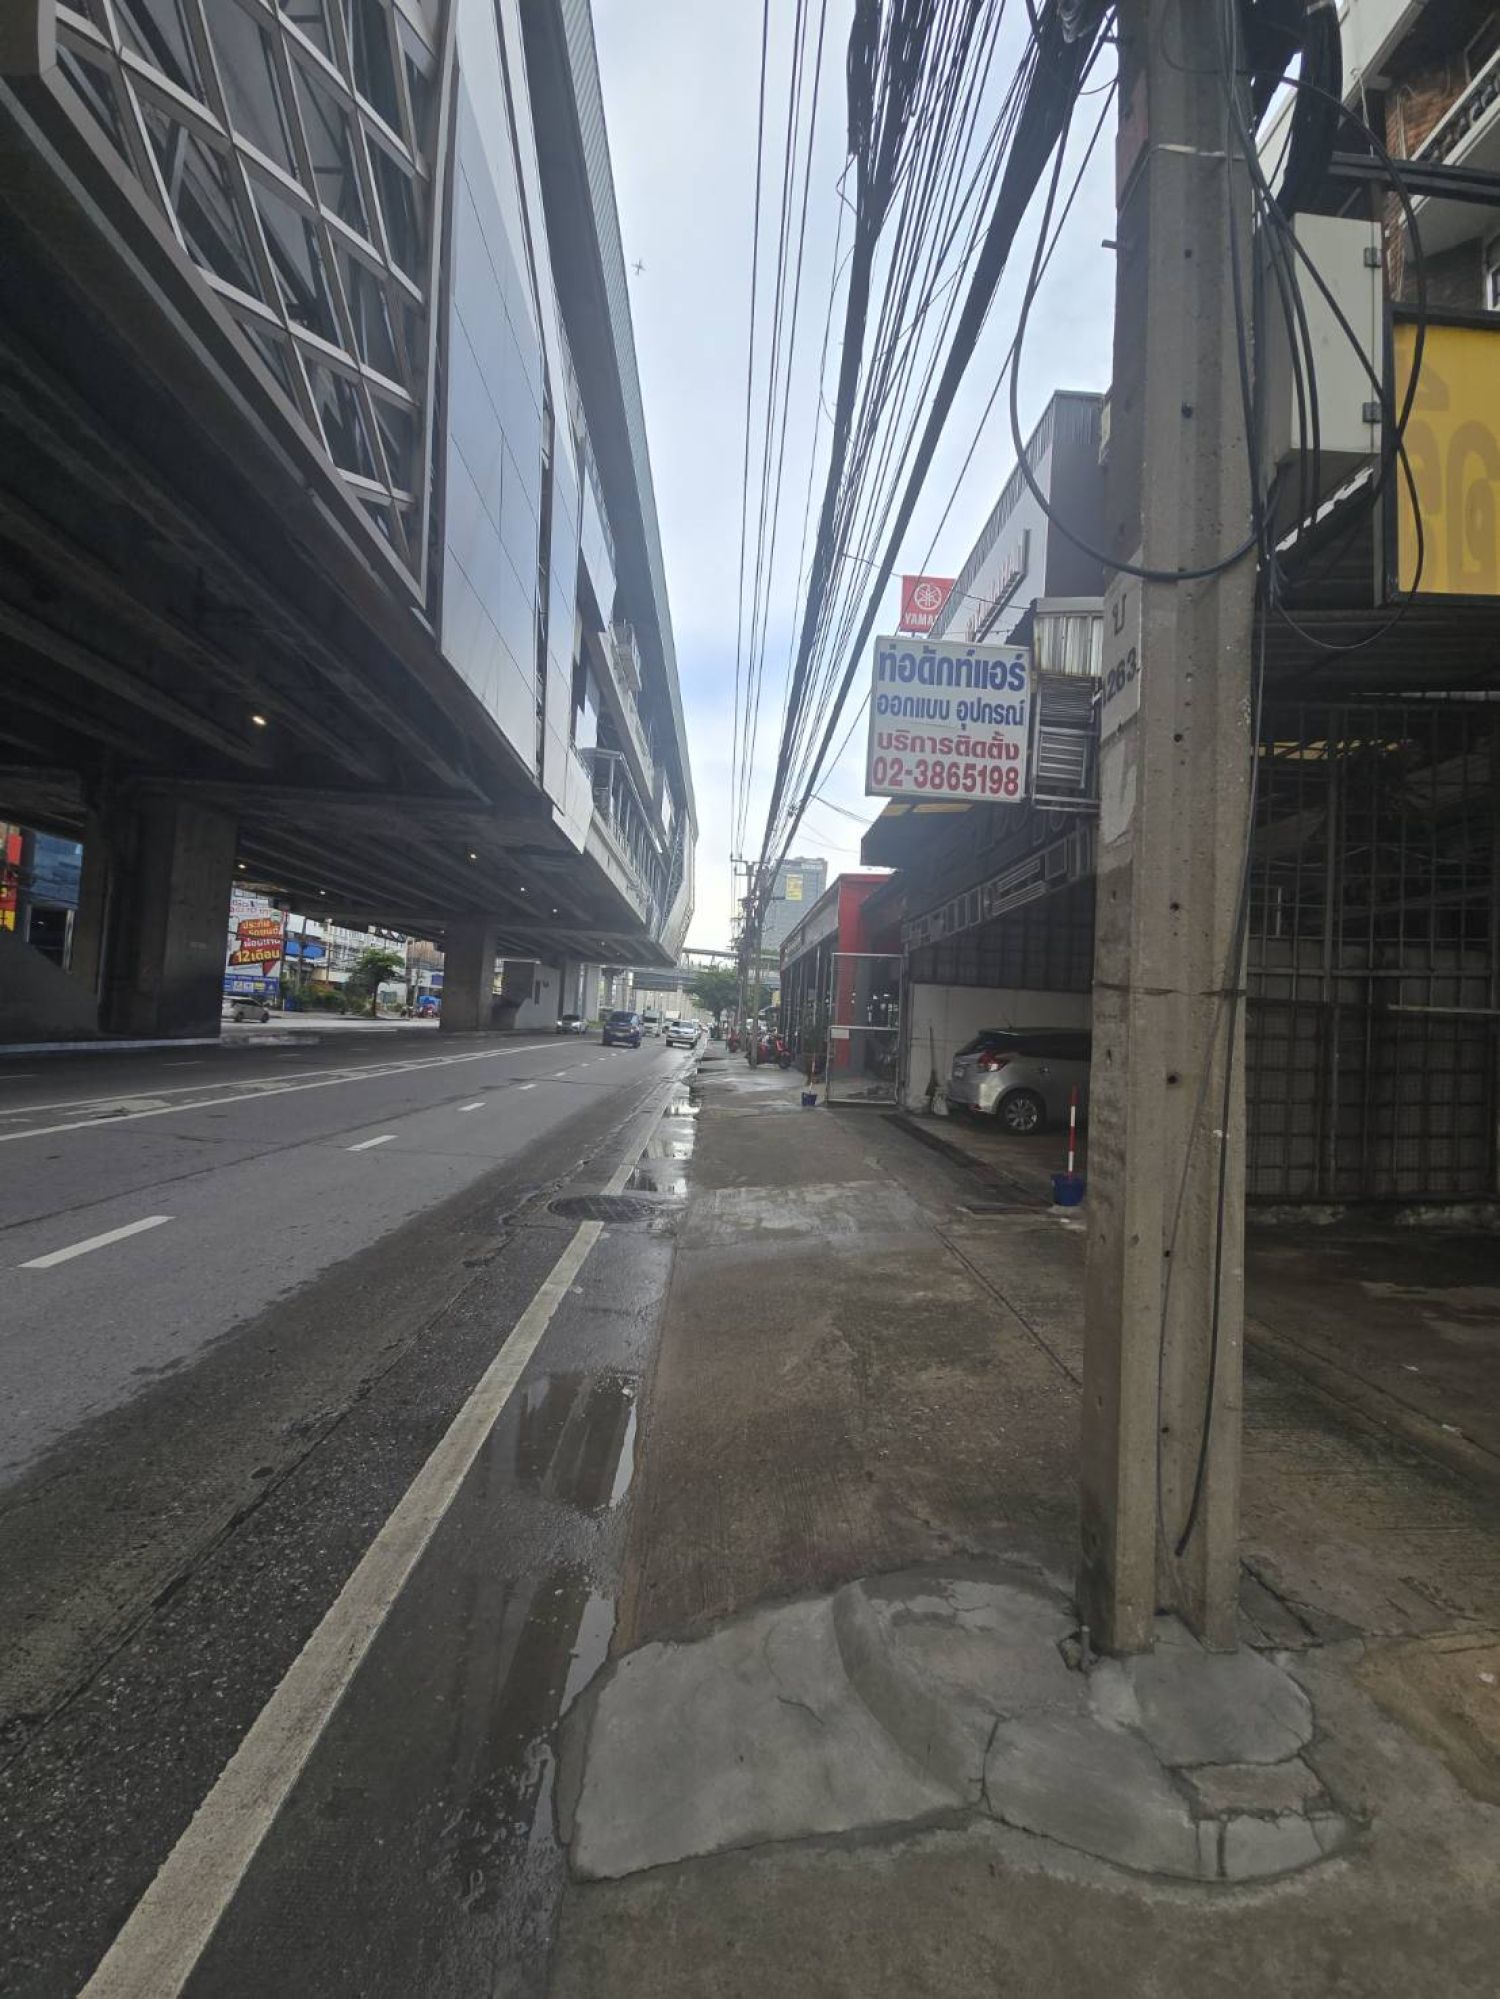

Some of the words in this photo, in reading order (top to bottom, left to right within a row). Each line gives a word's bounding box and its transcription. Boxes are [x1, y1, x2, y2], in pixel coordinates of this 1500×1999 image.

[904, 612, 937, 626] YAMA
[878, 643, 1026, 692] ท่อดักท์แอร์
[876, 693, 950, 720] ออกแบบ
[956, 697, 1026, 731] อุปกรณ์
[877, 729, 1020, 761] บริการติดตั้ง
[872, 755, 1019, 797] 02-3865198
